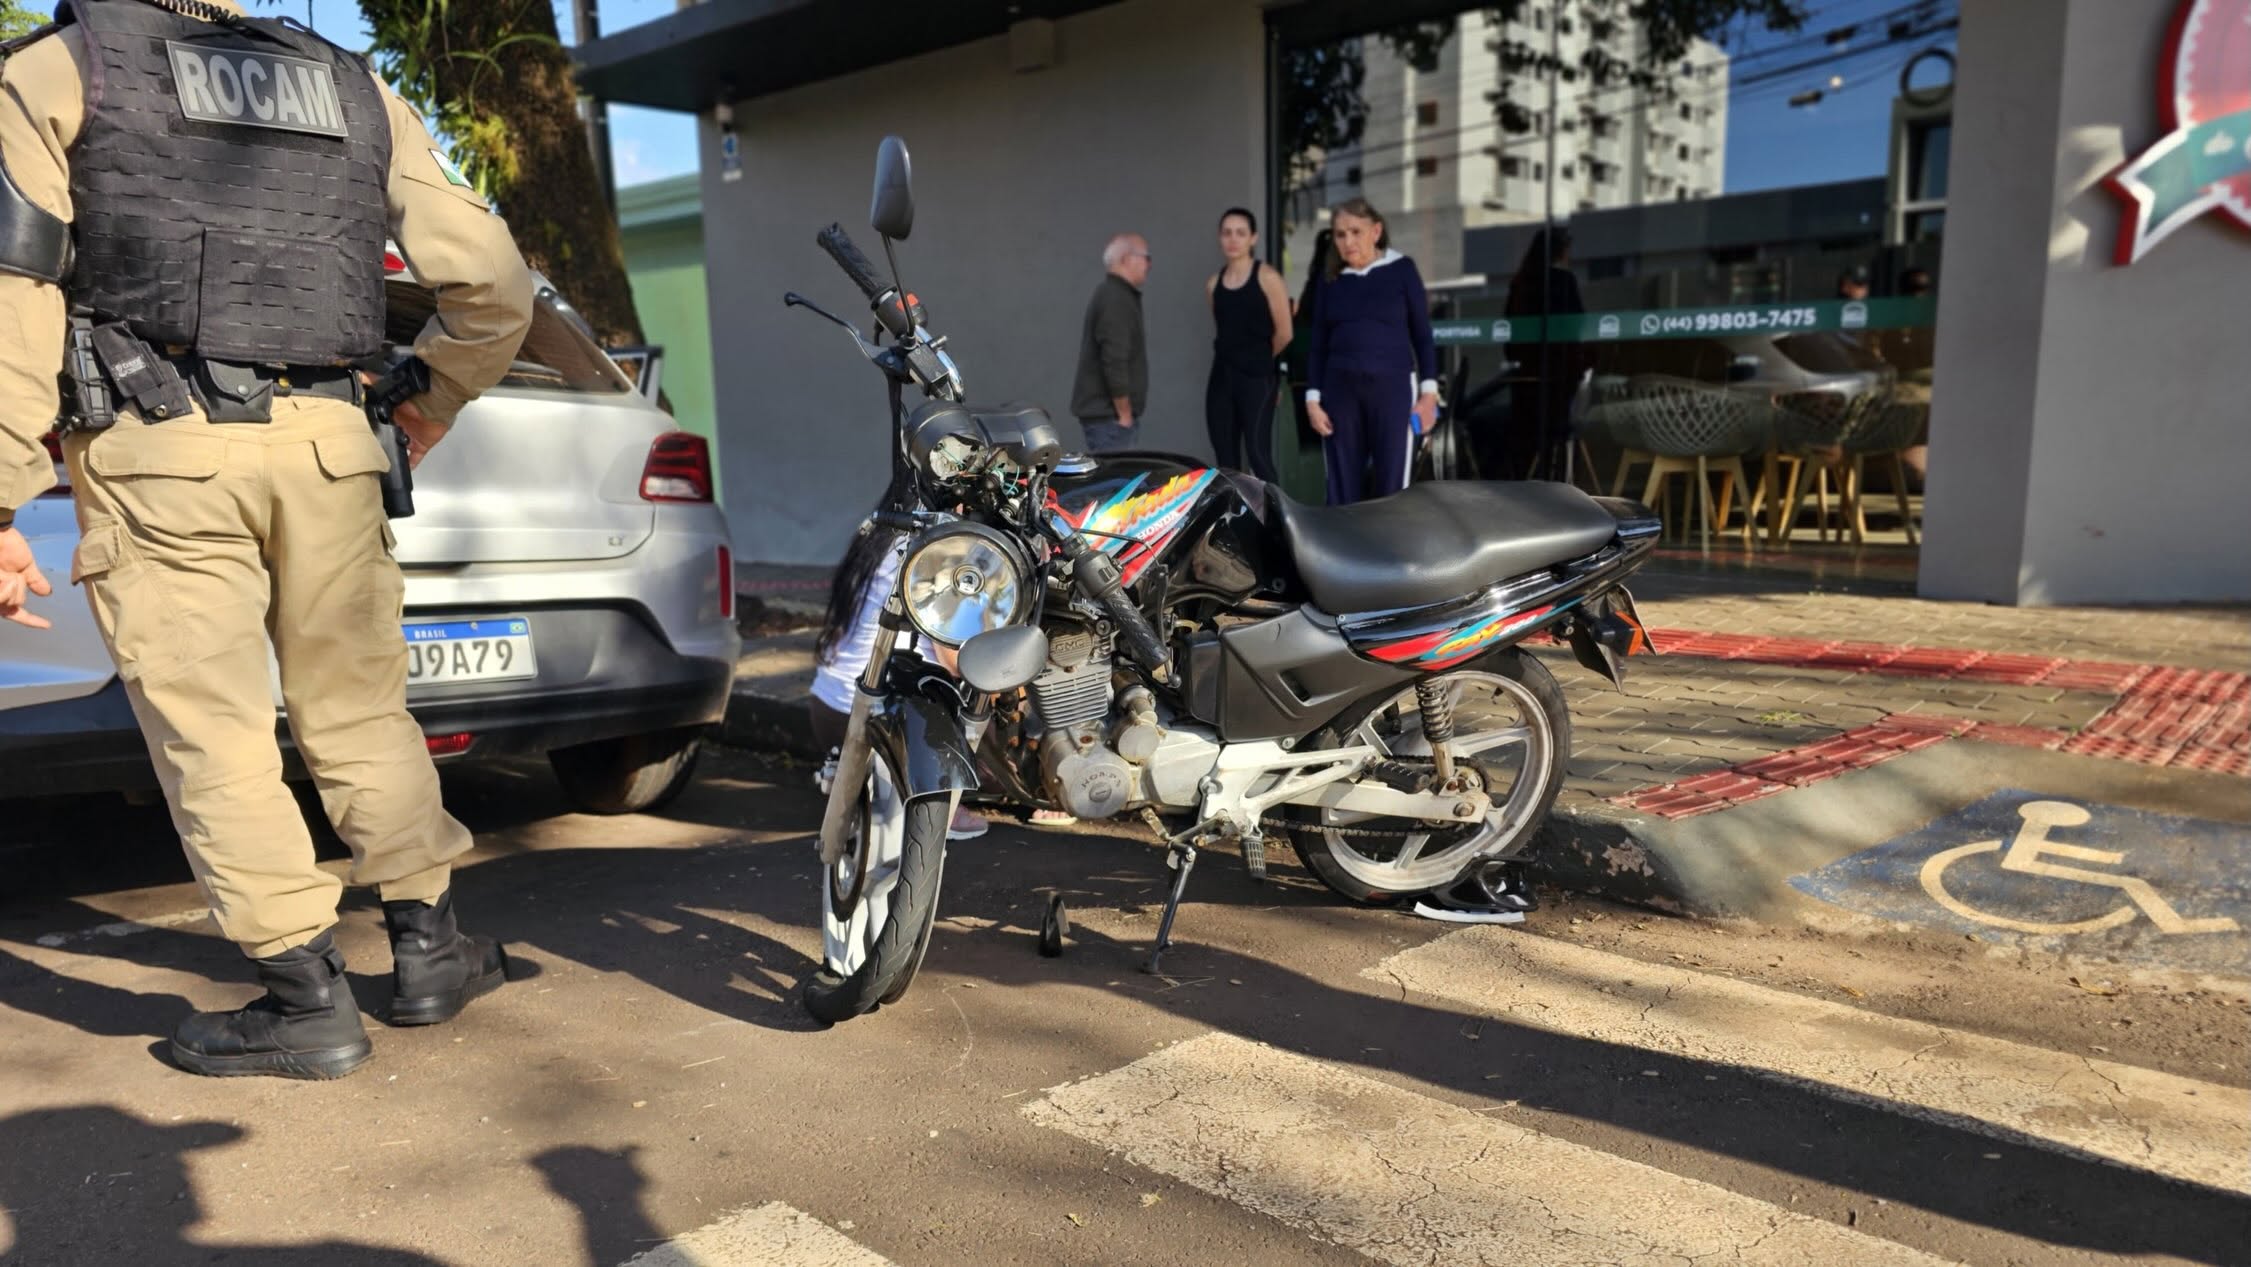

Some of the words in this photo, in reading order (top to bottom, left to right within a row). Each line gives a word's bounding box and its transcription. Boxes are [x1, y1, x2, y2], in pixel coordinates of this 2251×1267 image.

[174, 49, 340, 129] ROCAM
[1663, 316, 1692, 332] (44)
[1695, 307, 1817, 330] 99803-7475
[1136, 510, 1181, 541] HONDA
[414, 629, 448, 640] BRASIL
